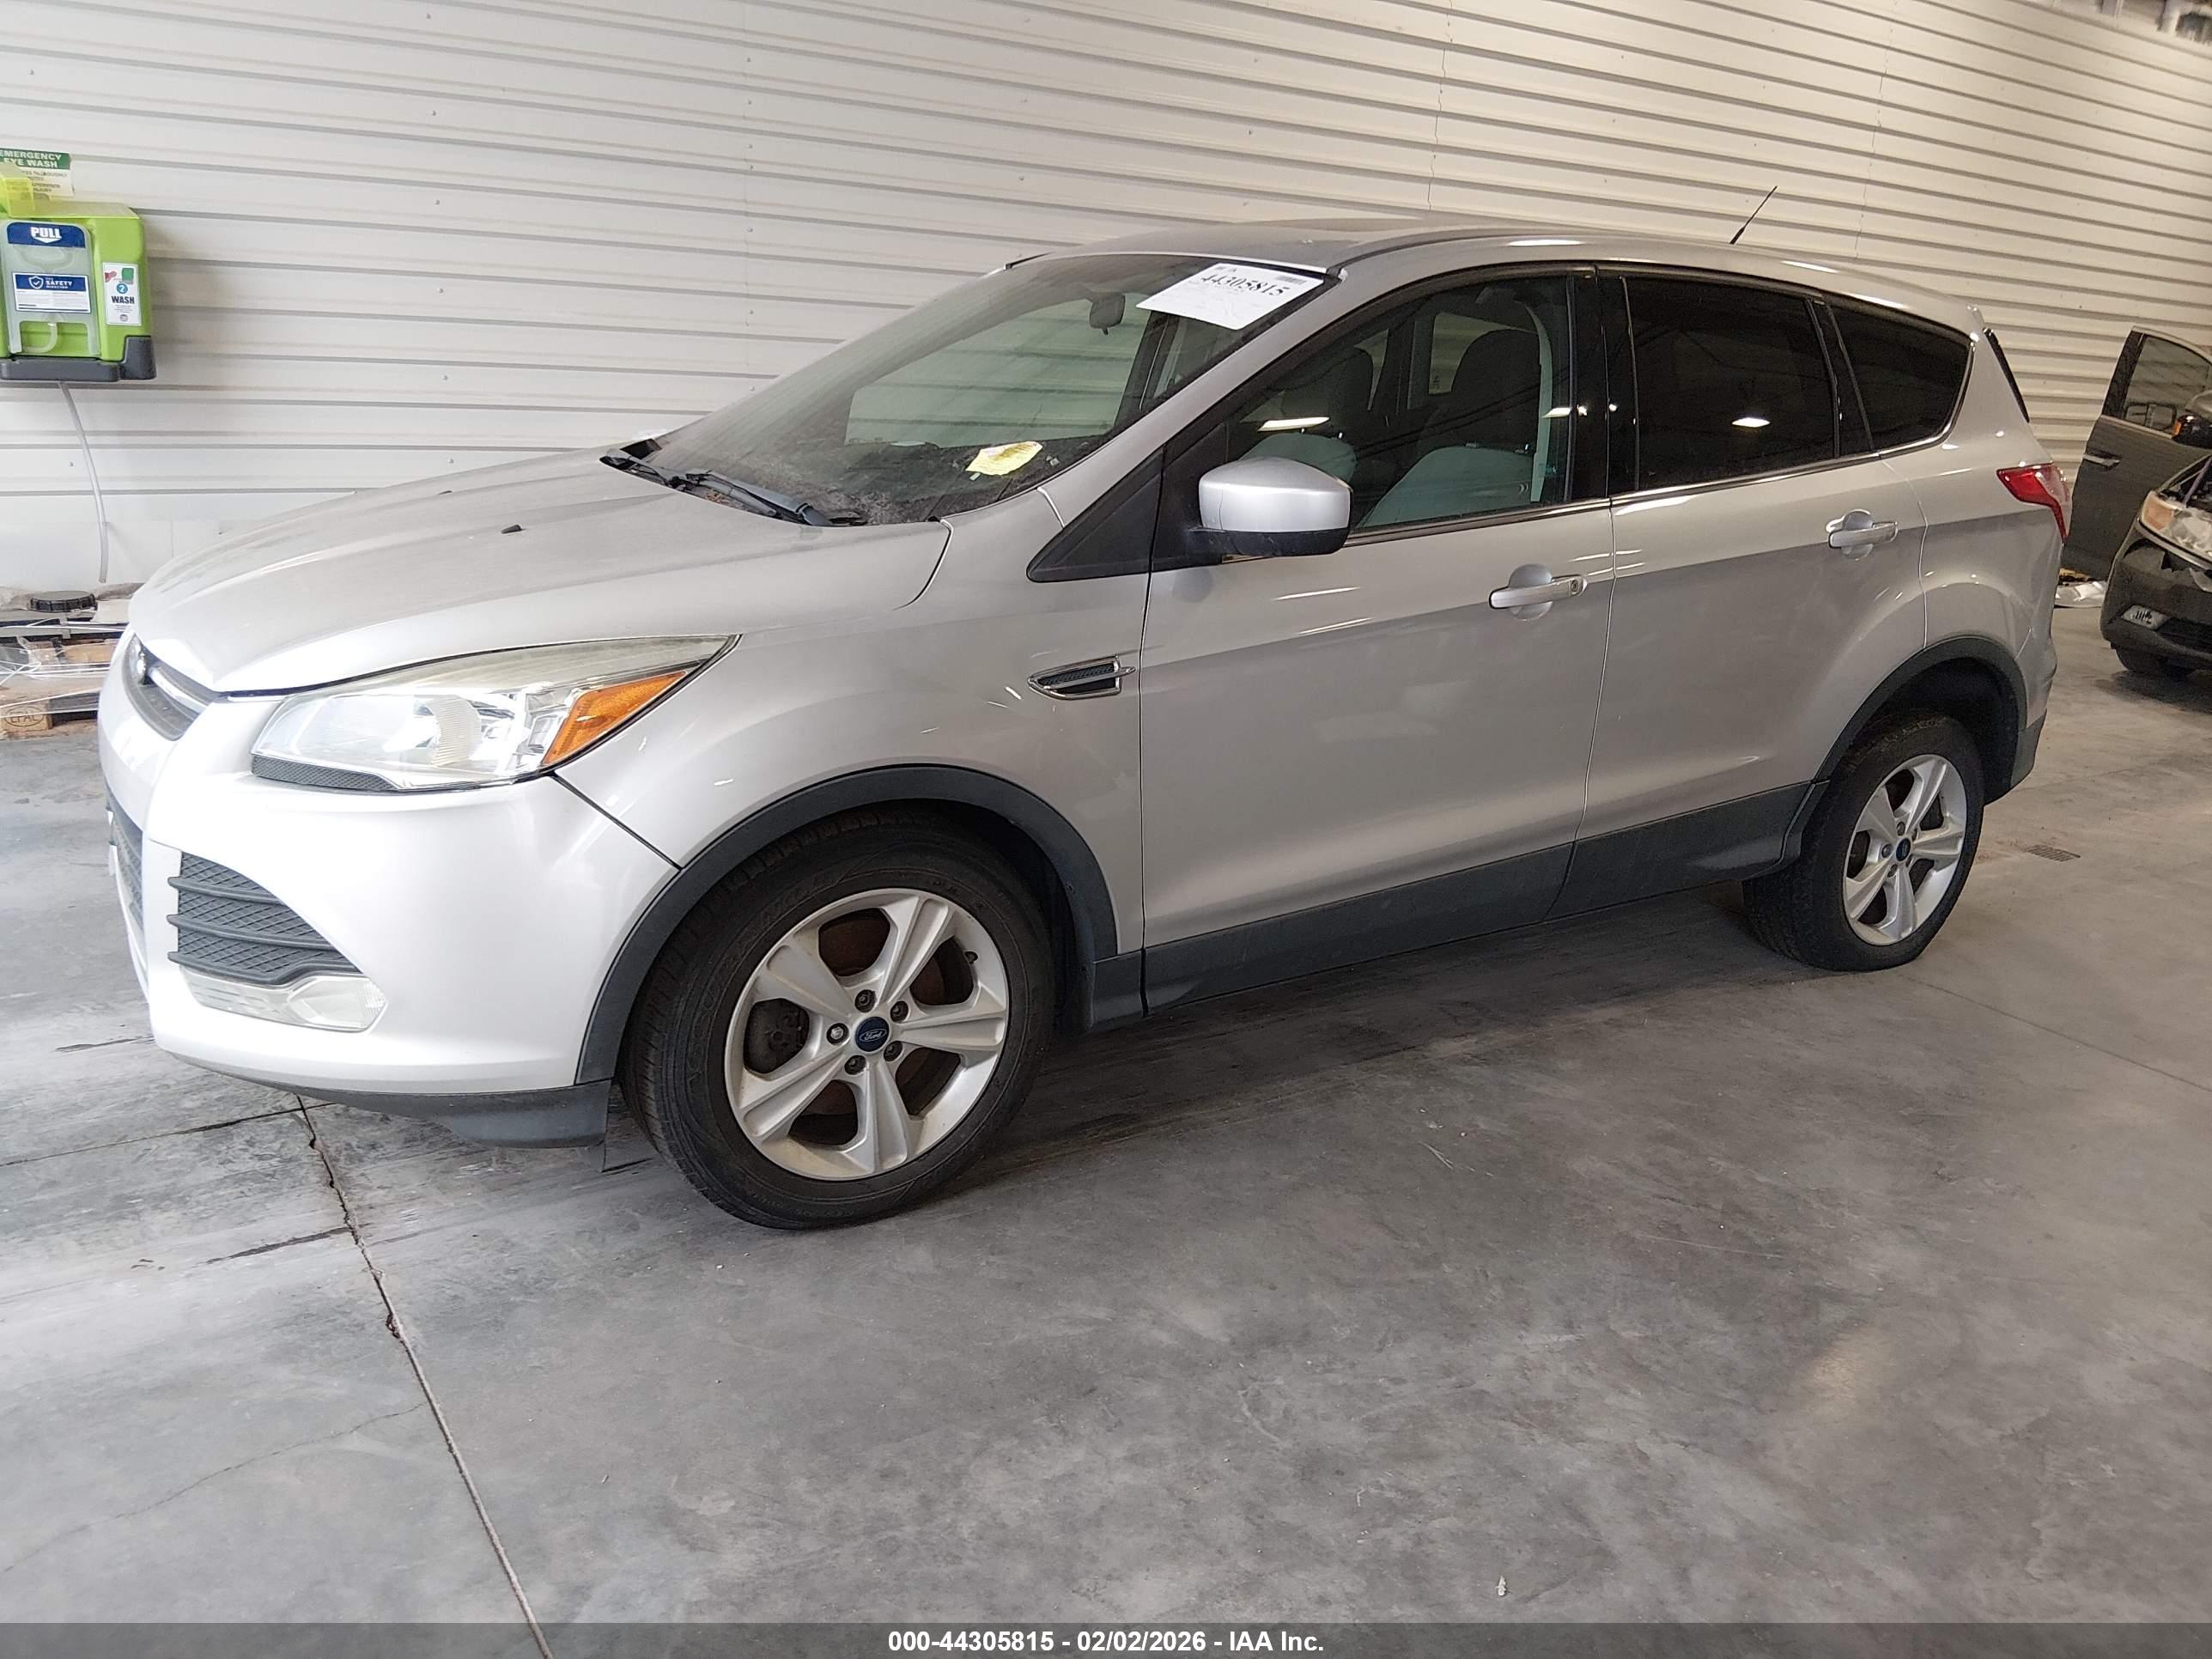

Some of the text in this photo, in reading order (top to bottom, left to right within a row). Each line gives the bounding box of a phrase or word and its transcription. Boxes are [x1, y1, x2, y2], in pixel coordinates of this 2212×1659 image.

[0, 149, 62, 161] EMERGENCY
[27, 160, 58, 168] WASH
[31, 227, 62, 238] PULL
[1202, 274, 1291, 296] 44305815
[111, 295, 135, 304] WASH
